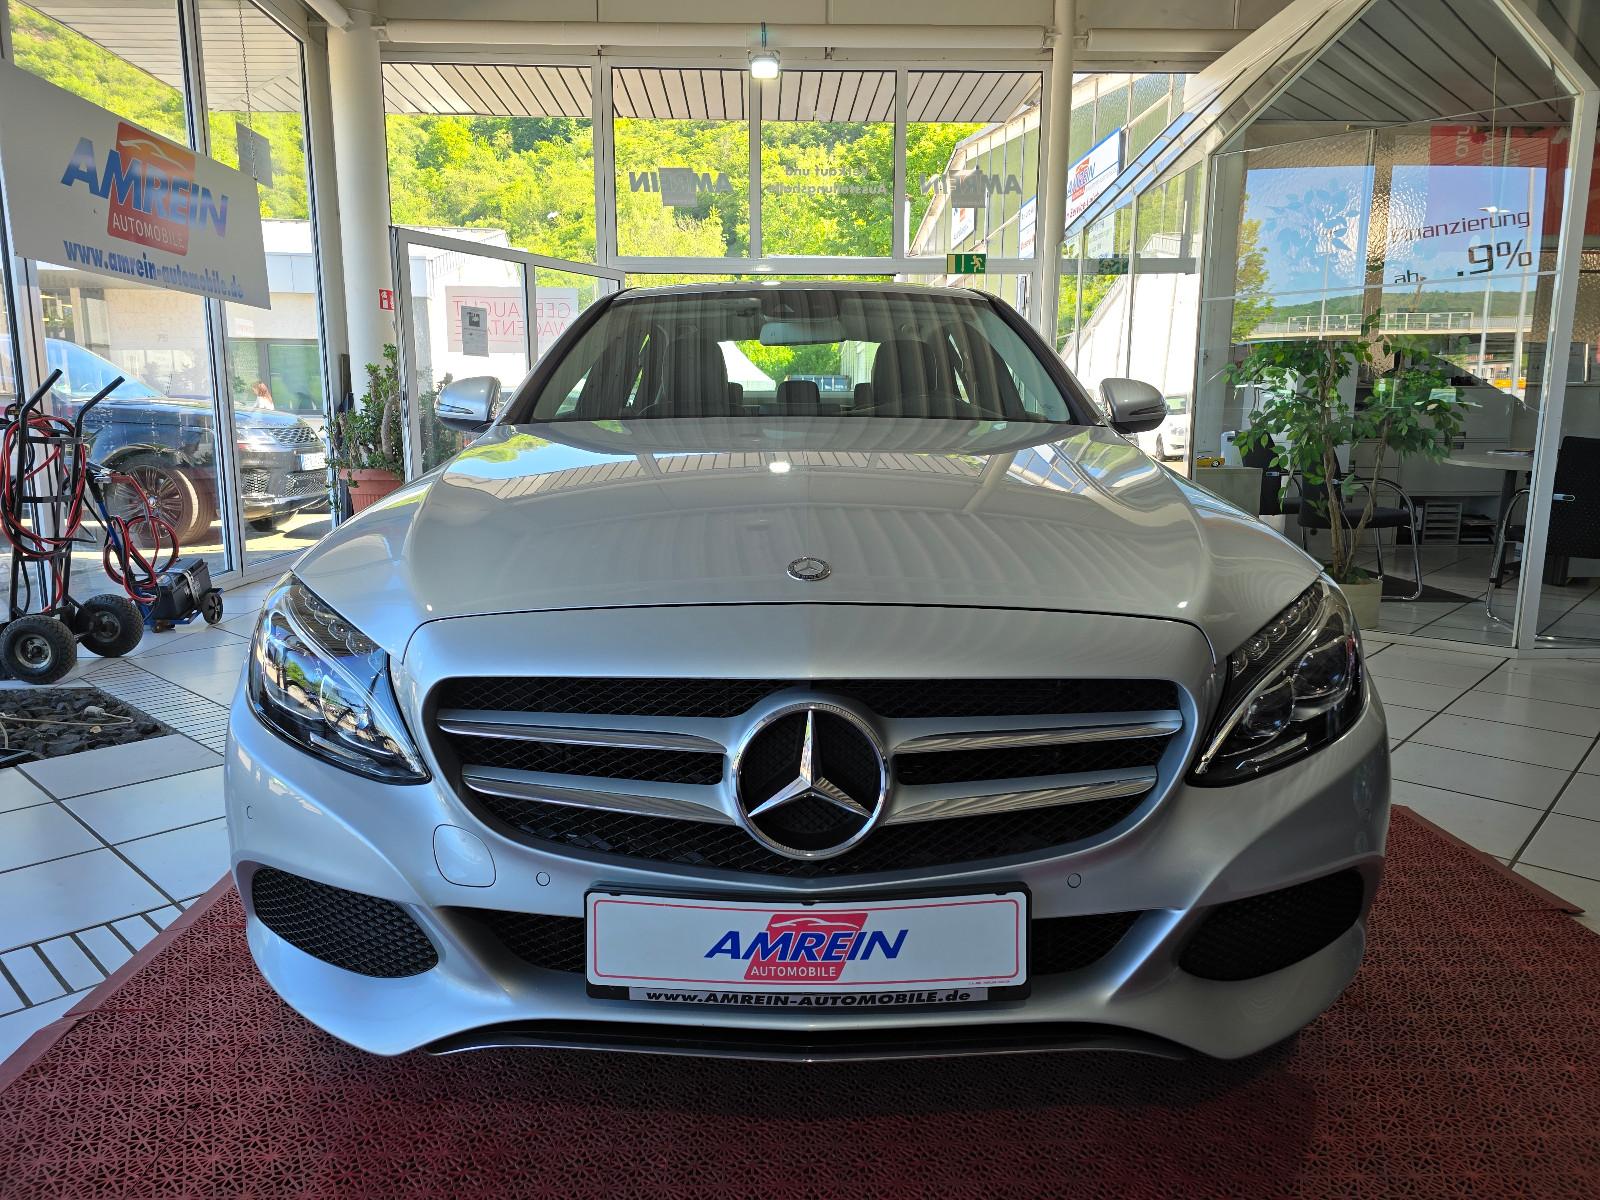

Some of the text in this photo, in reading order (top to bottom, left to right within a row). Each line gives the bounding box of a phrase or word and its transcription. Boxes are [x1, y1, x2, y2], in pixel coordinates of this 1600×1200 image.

[61, 137, 229, 237] AMREIN
[112, 212, 185, 250] AUTOMOBILE
[63, 239, 245, 299] www.amrein-automobile.de
[703, 929, 909, 963] AMREIN
[750, 965, 837, 977] AUTOMOBILE
[646, 989, 971, 1008] www.AMREIN-AUTOMOBILE.de
